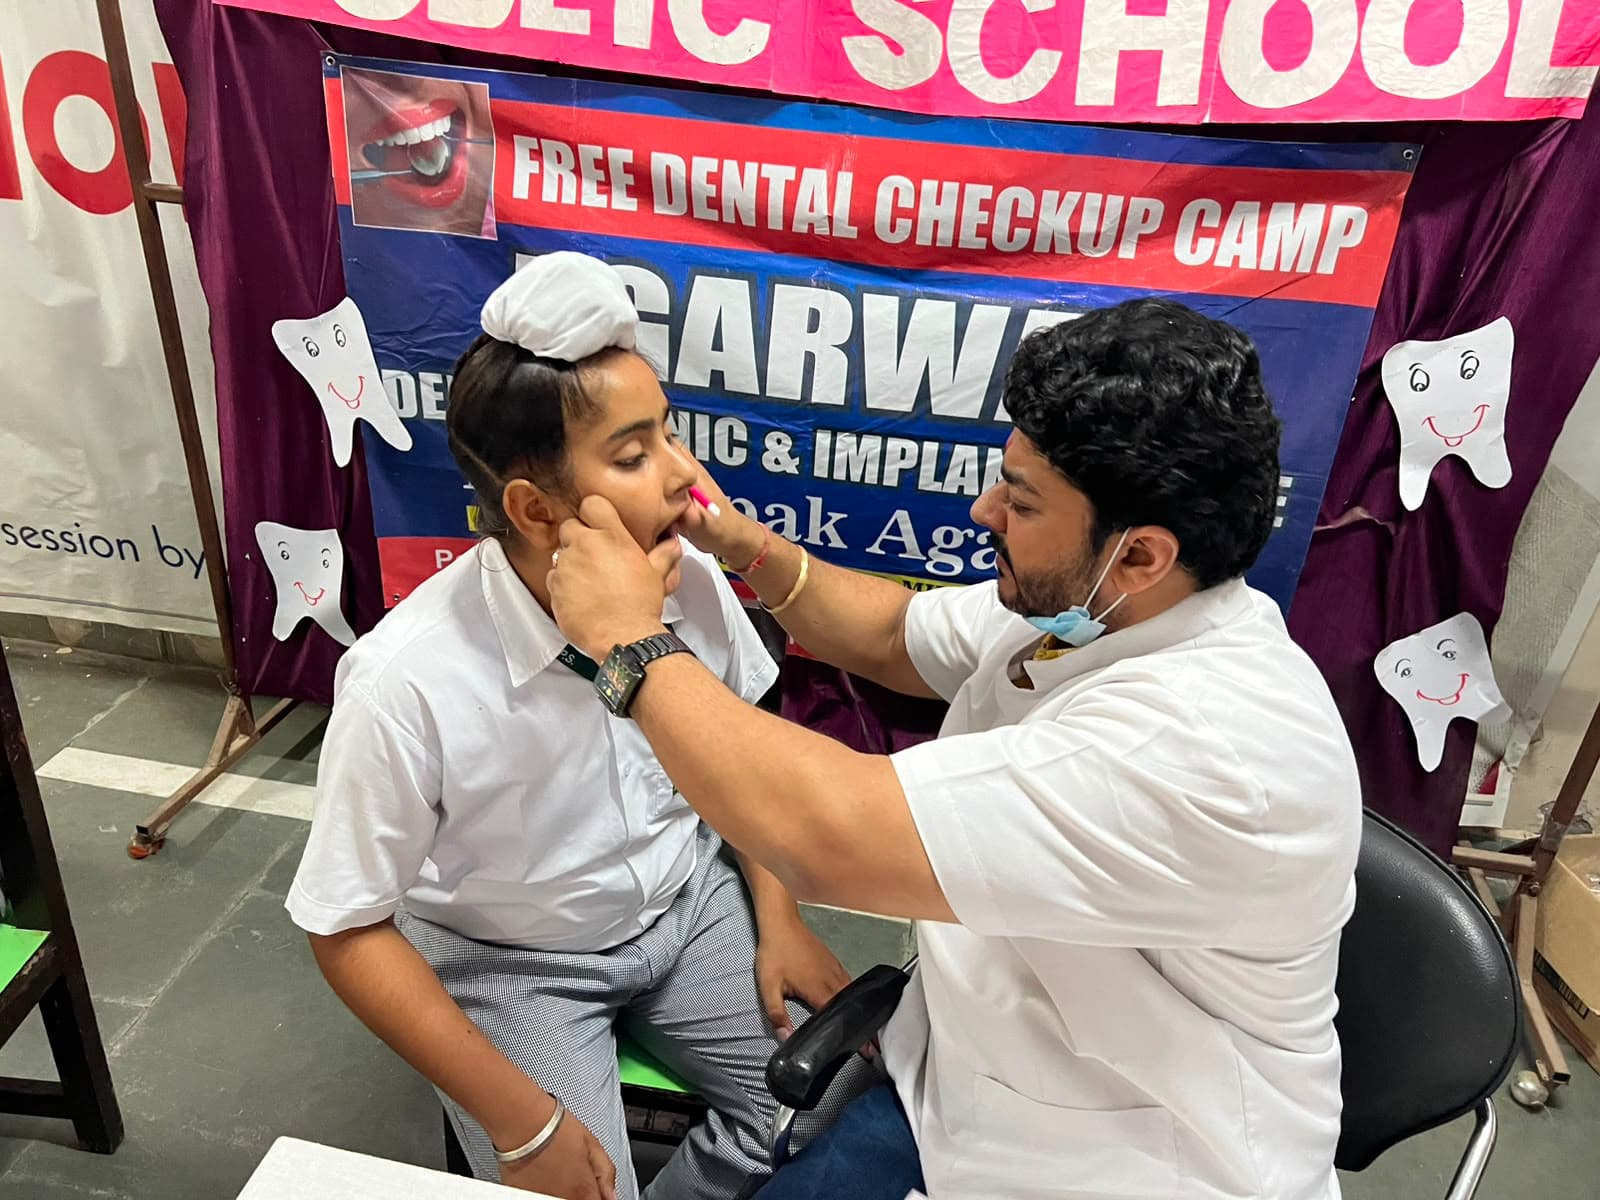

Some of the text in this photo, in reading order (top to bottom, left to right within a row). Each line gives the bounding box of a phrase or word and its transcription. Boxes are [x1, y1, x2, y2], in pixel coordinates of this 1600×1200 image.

[841, 0, 1600, 108] SCHOOL
[511, 135, 1368, 275] FREE DENTAL CHECKUP CAMP
[515, 253, 1085, 422] GARW
[762, 431, 800, 475] &
[1, 522, 205, 579] session by
